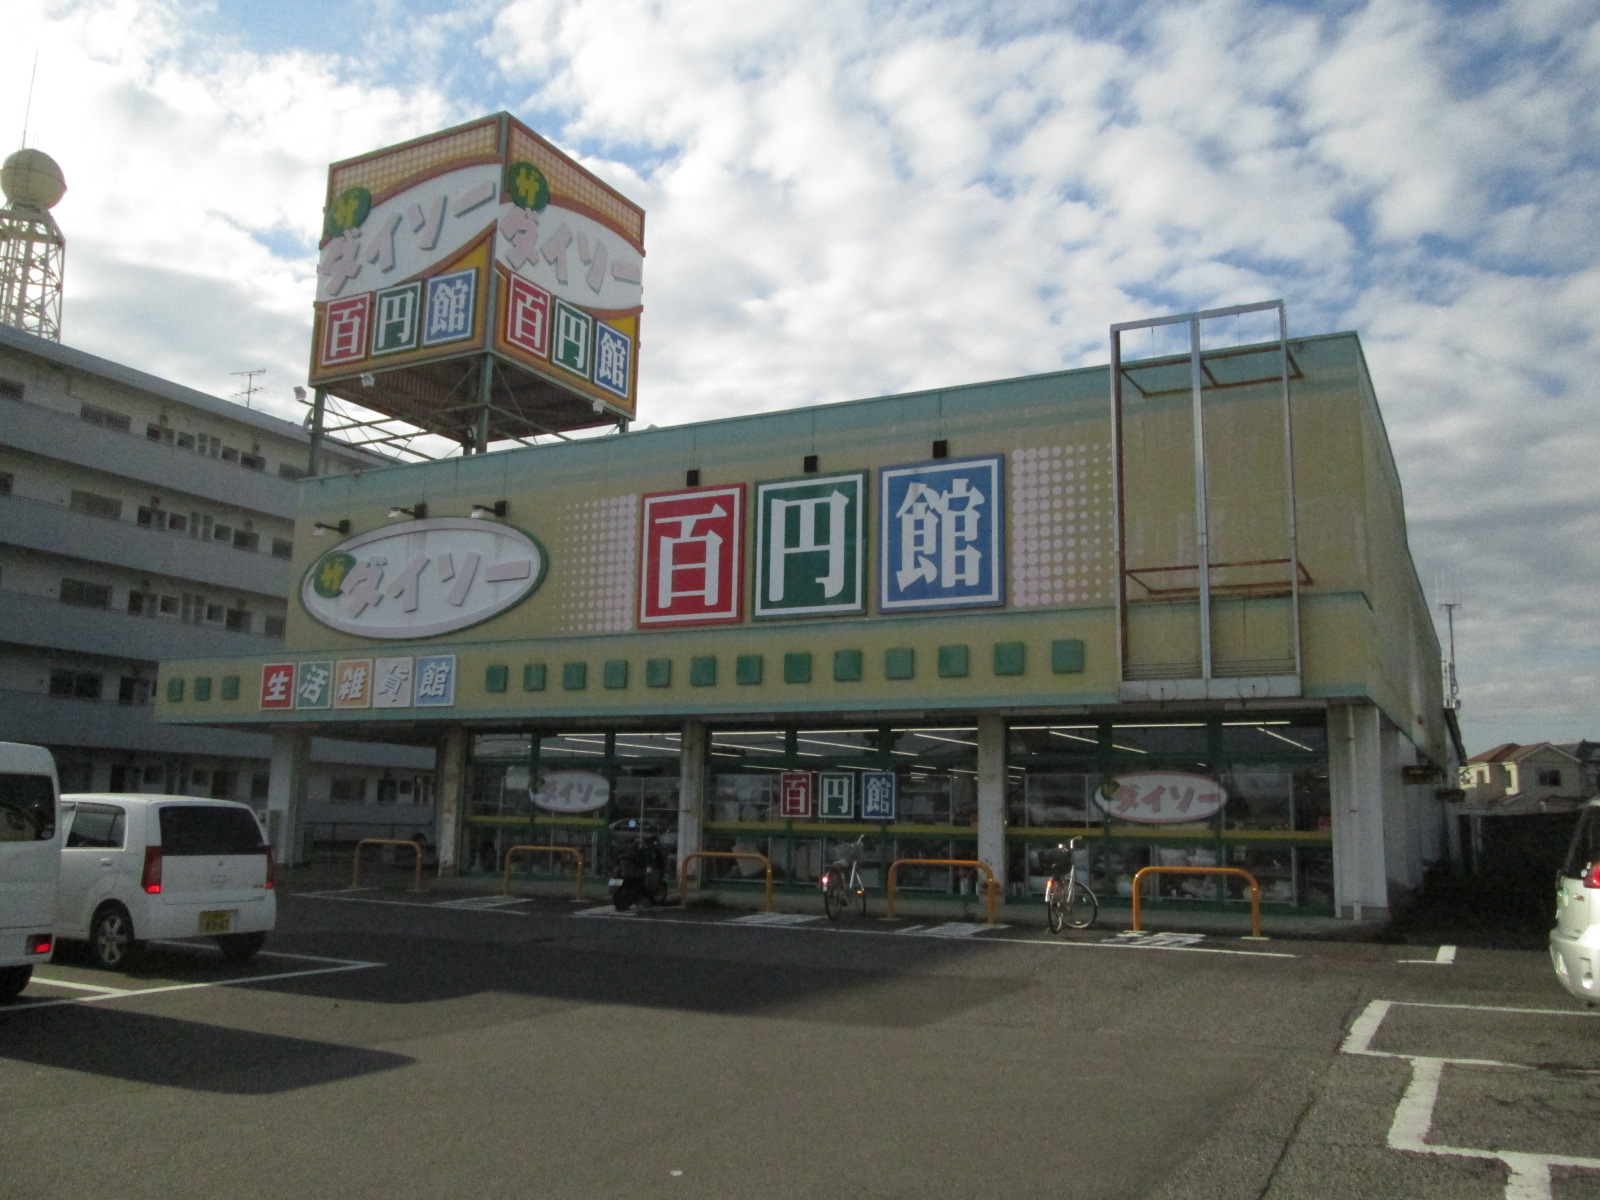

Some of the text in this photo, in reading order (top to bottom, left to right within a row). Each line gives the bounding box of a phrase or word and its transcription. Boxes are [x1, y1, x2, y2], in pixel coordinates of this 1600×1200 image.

[330, 279, 469, 357] 百円館
[515, 287, 627, 389] 百円館
[655, 478, 985, 609] 百円館
[340, 552, 531, 618] ダイソー
[264, 661, 450, 704] 生活雑貨館
[784, 776, 892, 814] 百円館
